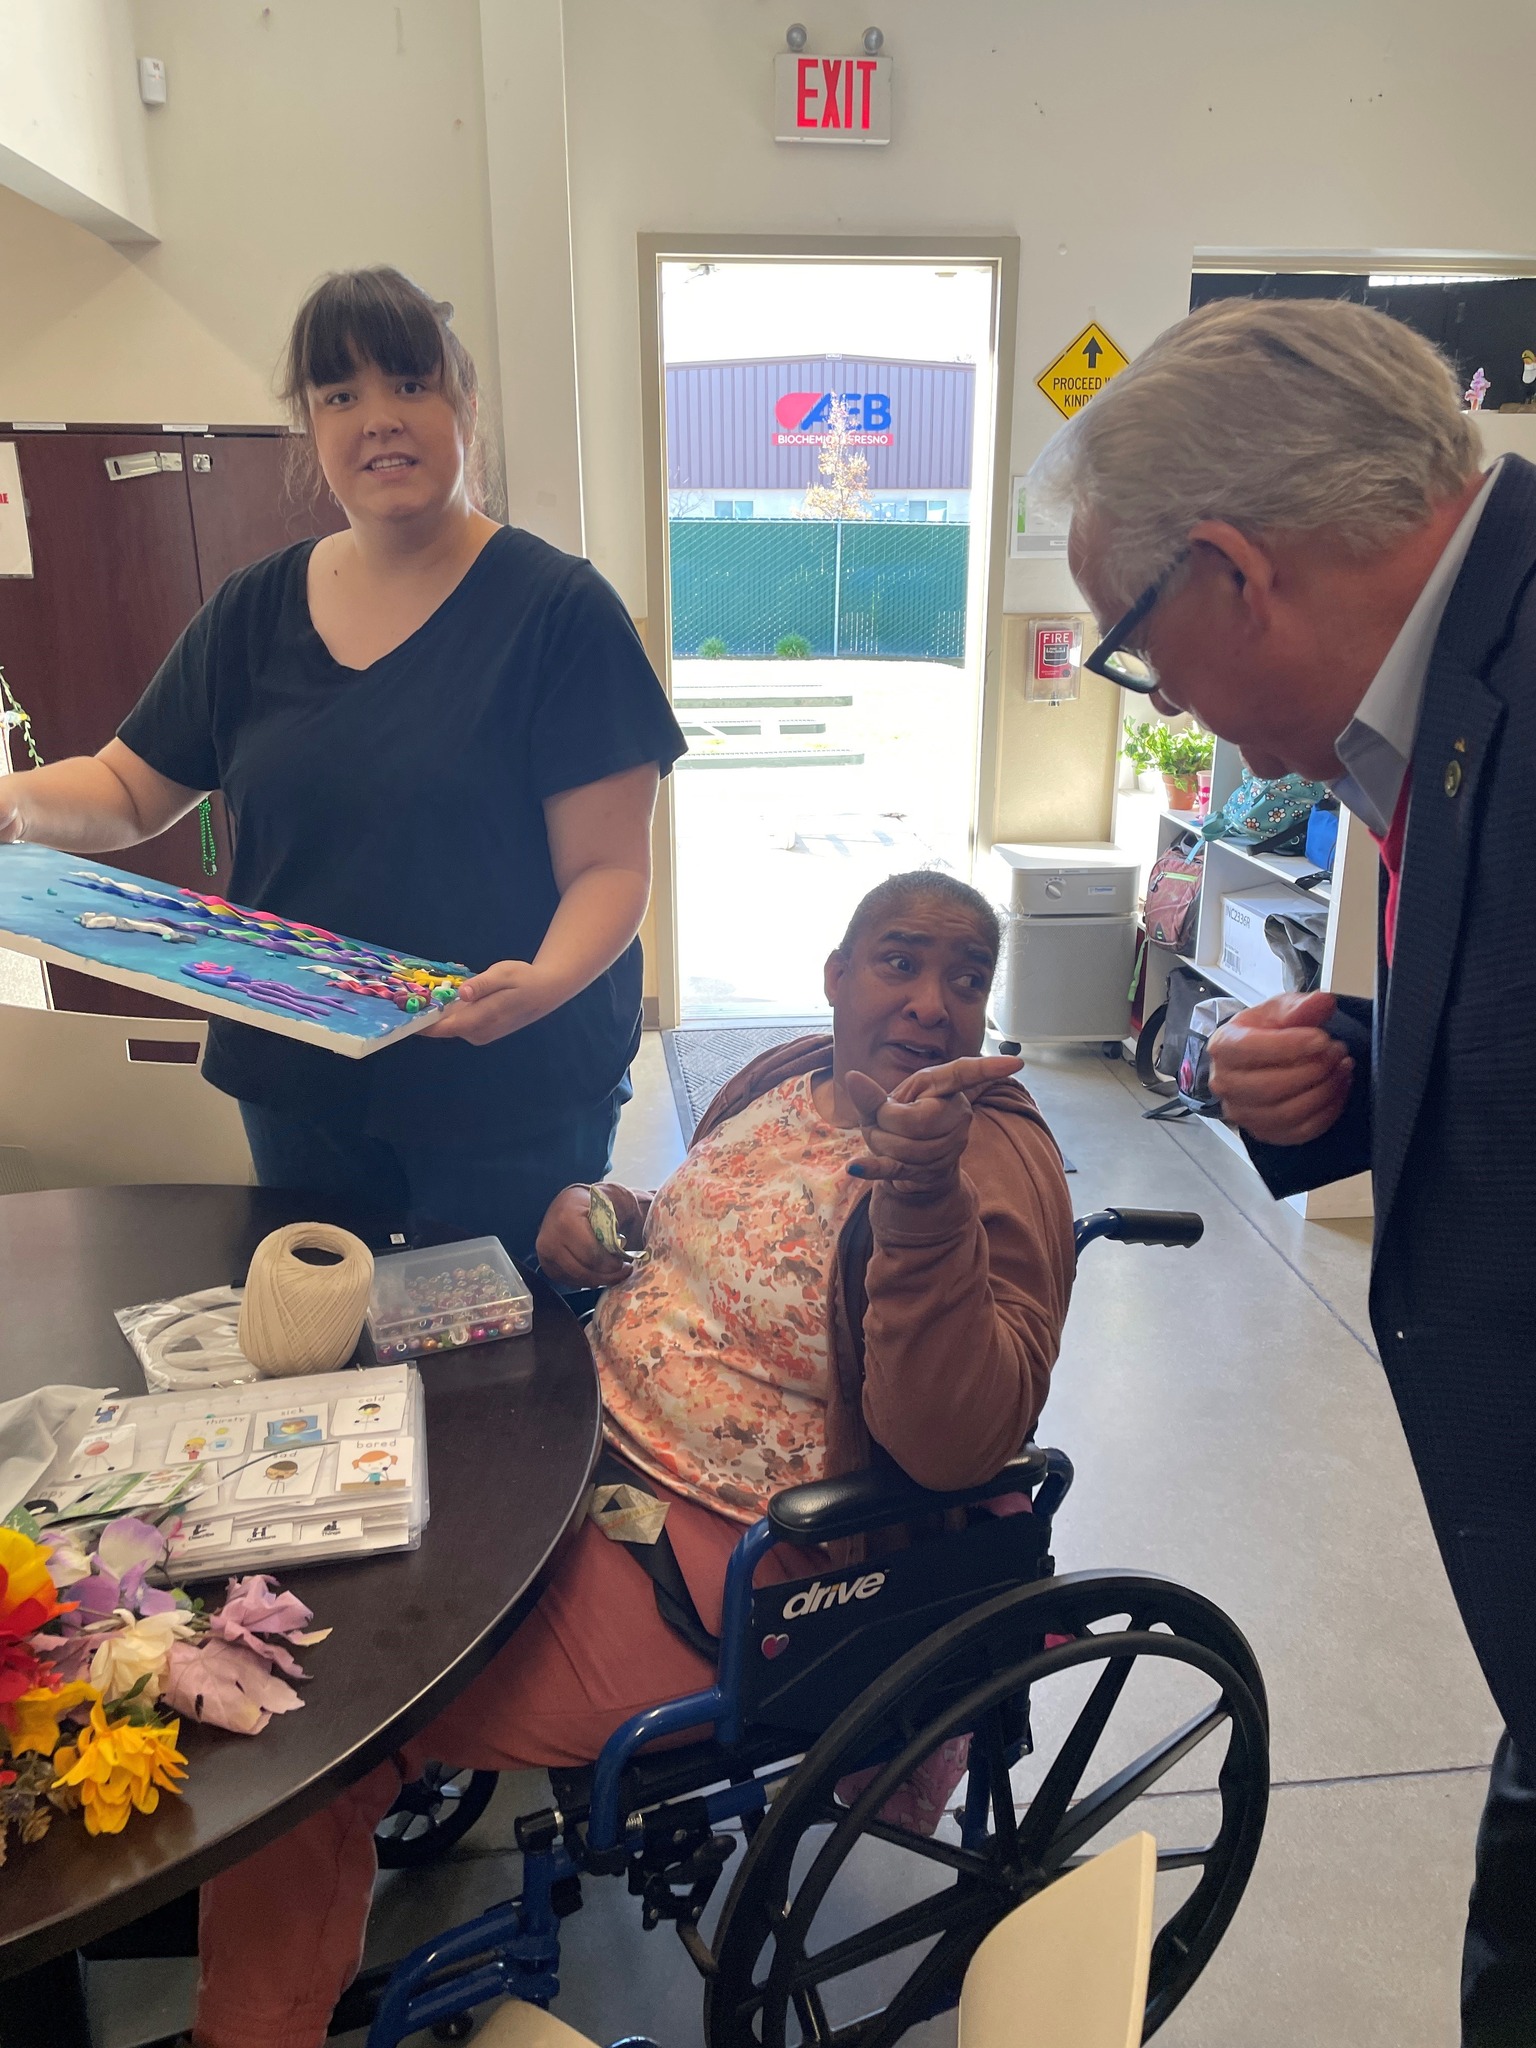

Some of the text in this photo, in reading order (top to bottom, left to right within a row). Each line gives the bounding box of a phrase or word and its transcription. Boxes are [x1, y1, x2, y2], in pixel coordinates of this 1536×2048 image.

[797, 58, 877, 129] EXIT
[1053, 377, 1102, 390] PROCEED
[1064, 394, 1093, 407] KIND
[801, 393, 891, 431] AEB
[1043, 633, 1070, 643] FIRE
[358, 1395, 386, 1403] cold
[356, 1439, 397, 1449] bored
[783, 1572, 885, 1619] drive
